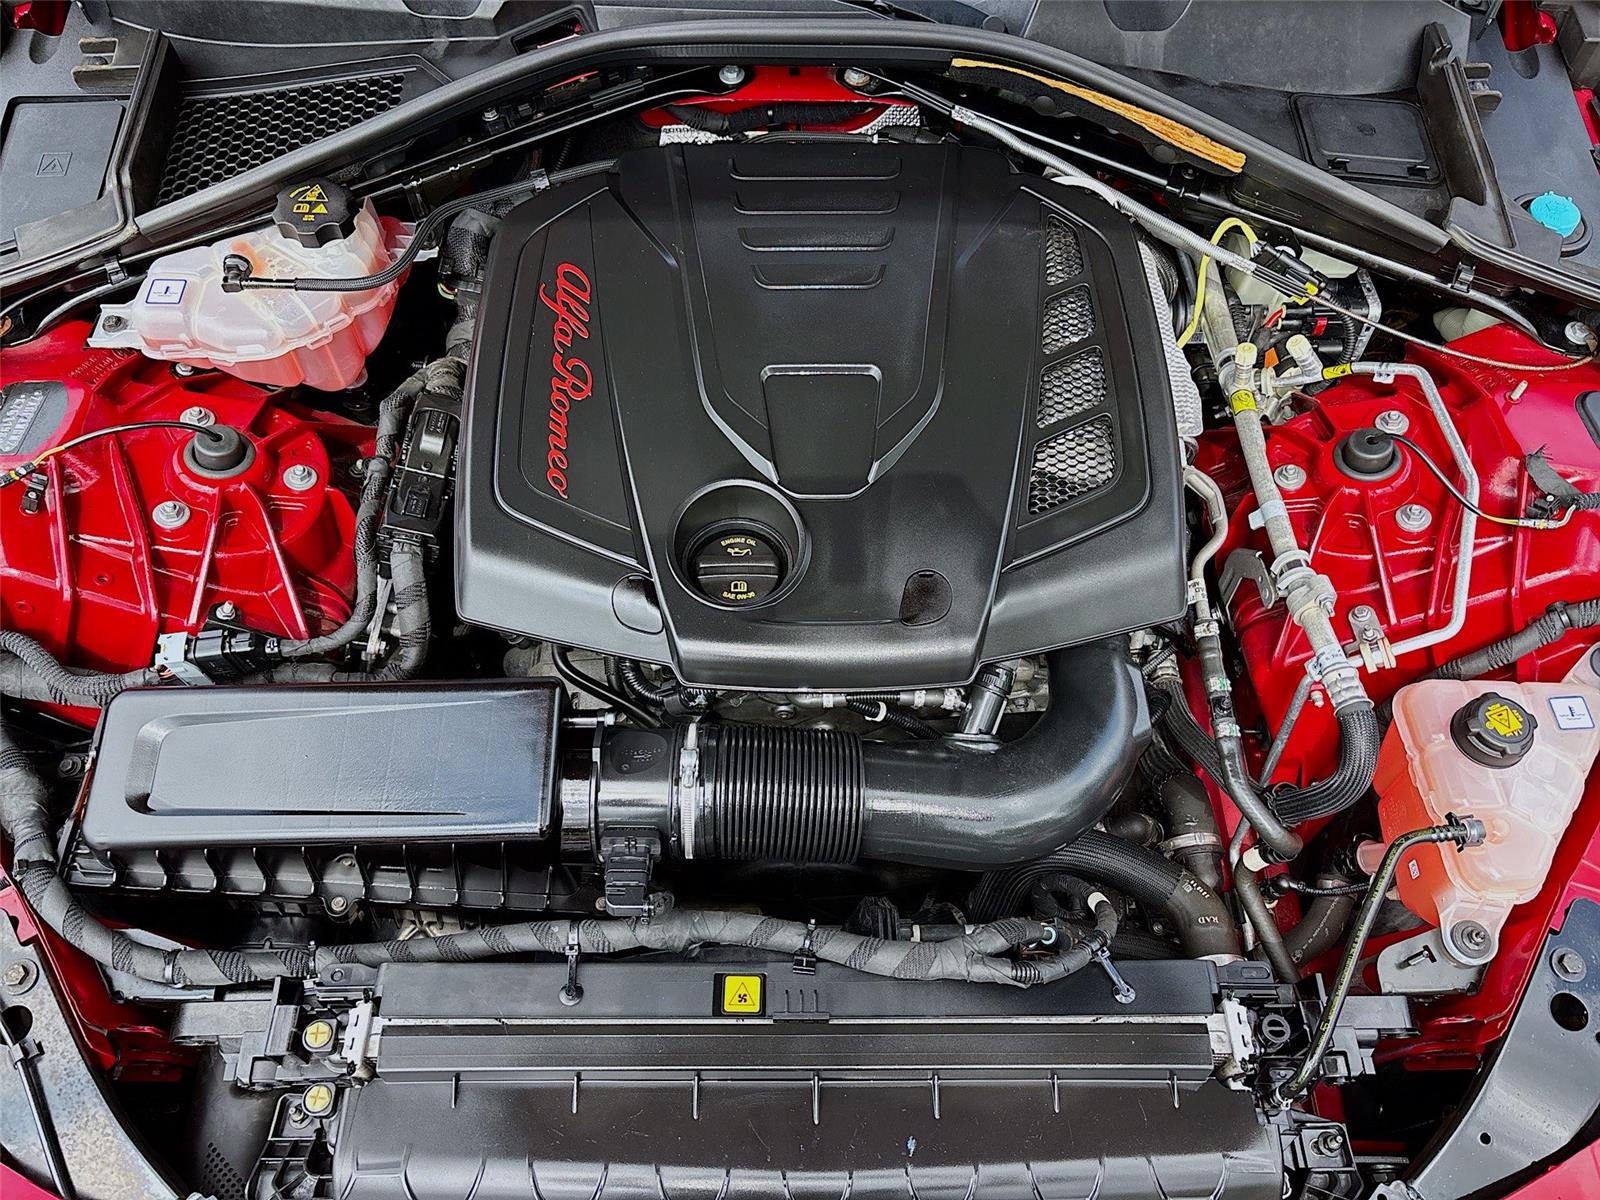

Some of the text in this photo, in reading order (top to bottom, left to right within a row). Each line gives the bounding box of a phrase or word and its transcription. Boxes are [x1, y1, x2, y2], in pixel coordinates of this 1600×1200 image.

[539, 263, 593, 499] Alfa Romeo
[721, 538, 756, 547] ENGINE OIL
[722, 591, 736, 600] SAE
